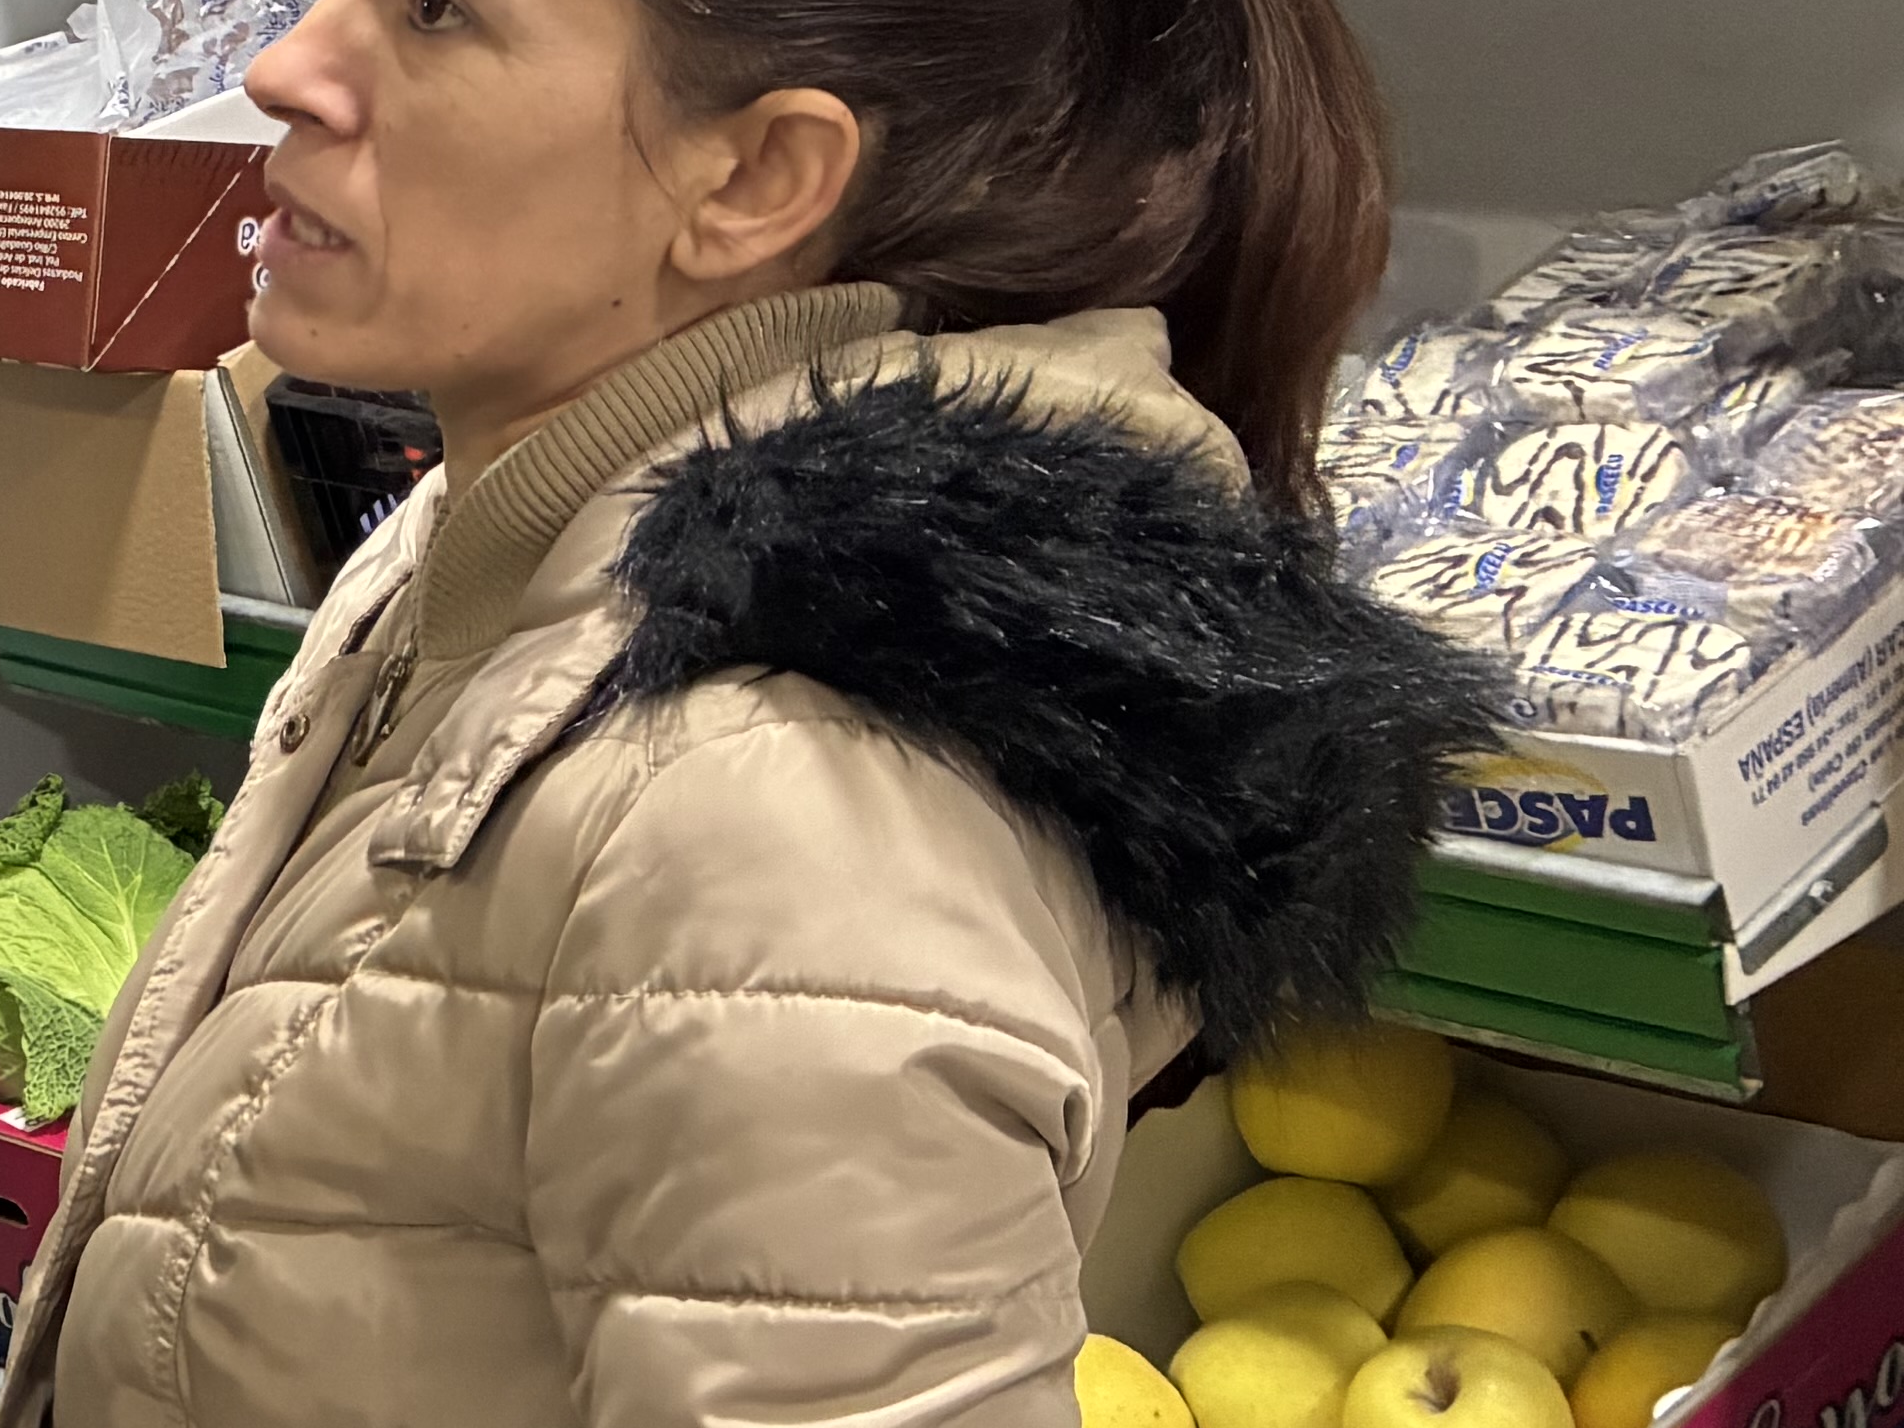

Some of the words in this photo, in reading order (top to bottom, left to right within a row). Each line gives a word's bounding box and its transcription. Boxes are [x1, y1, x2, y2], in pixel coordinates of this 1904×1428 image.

[0, 214, 42, 227] Antequera
[8, 227, 56, 241] Empresarial
[0, 265, 9, 274] de
[10, 264, 41, 277] Delicias
[42, 268, 83, 282] Productos
[1, 276, 45, 291] Fabricado
[1738, 710, 1806, 783] ESPAÑA
